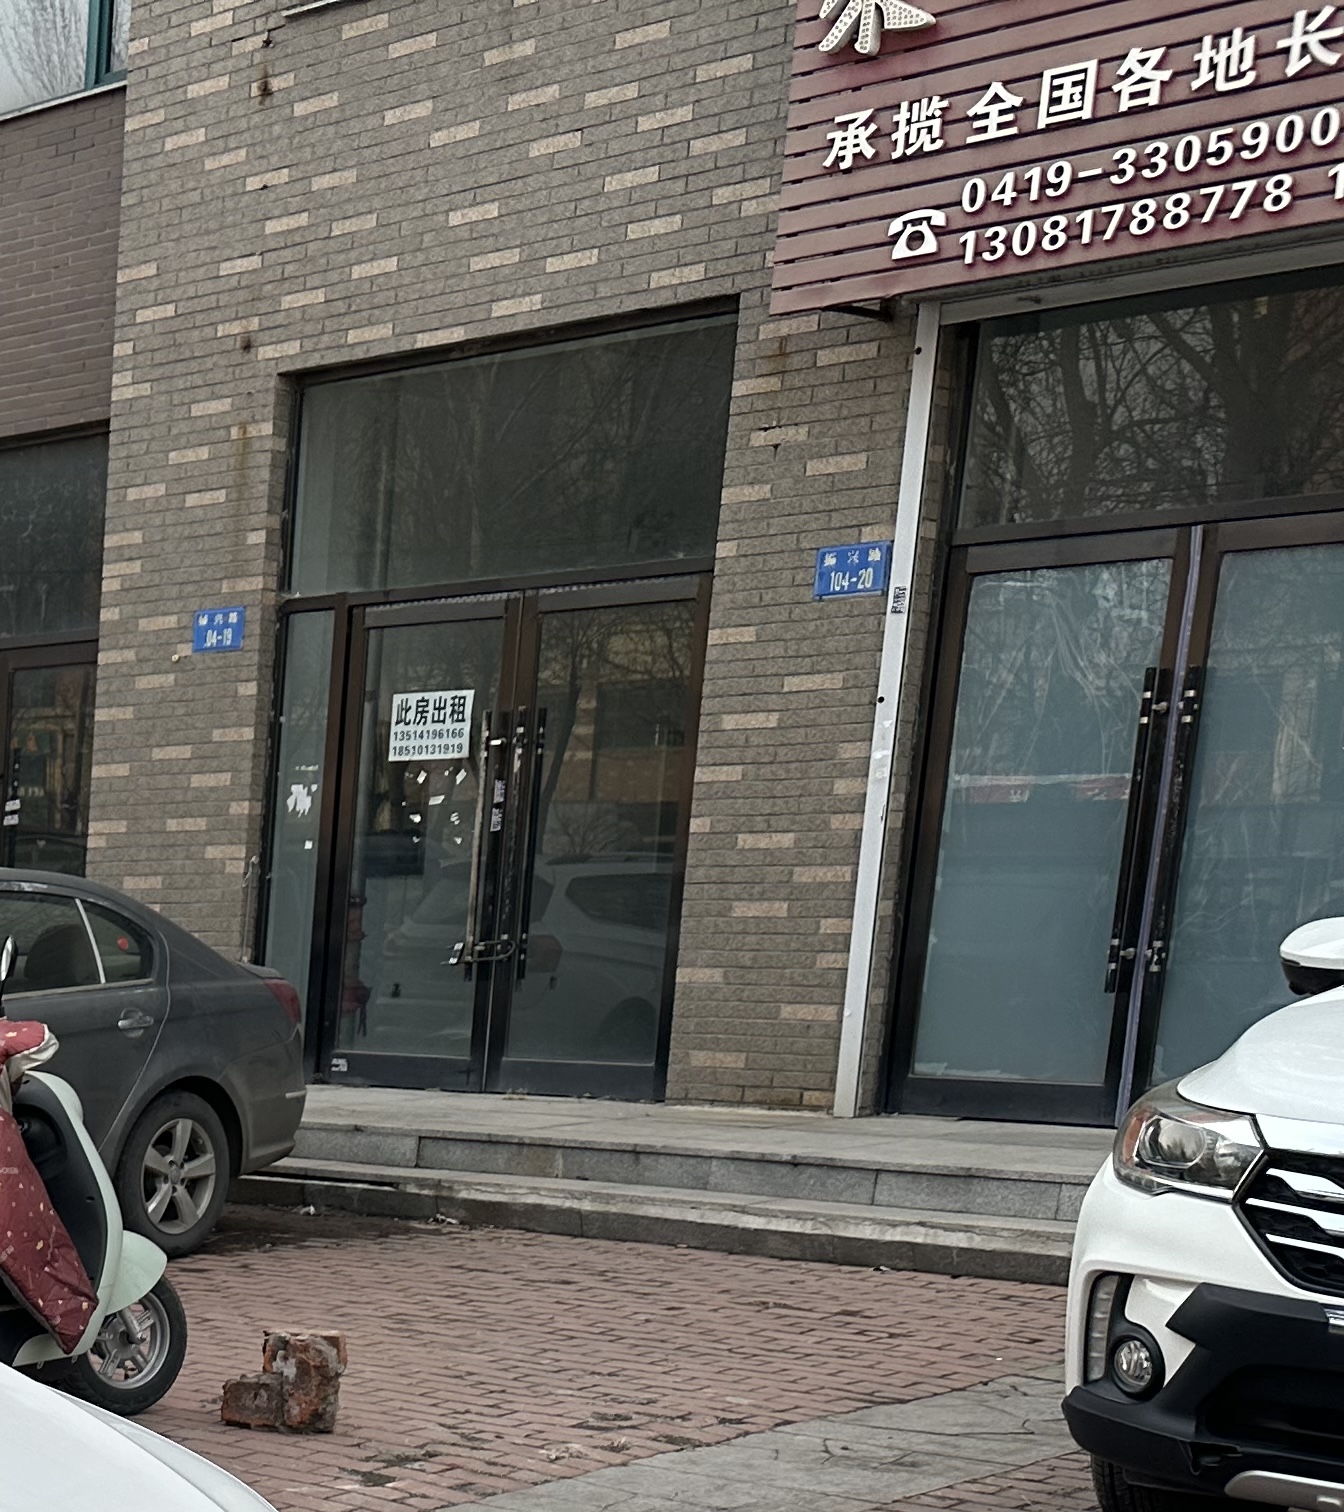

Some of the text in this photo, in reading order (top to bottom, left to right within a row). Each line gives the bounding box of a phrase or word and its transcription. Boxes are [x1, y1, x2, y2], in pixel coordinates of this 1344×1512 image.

[961, 107, 1340, 214] 0419-3305900
[958, 173, 1293, 266] 13081788778
[830, 567, 874, 592] 104-20
[395, 695, 466, 726] 此房出租
[394, 728, 464, 741] 13514196166
[392, 743, 463, 756] 18510131919
